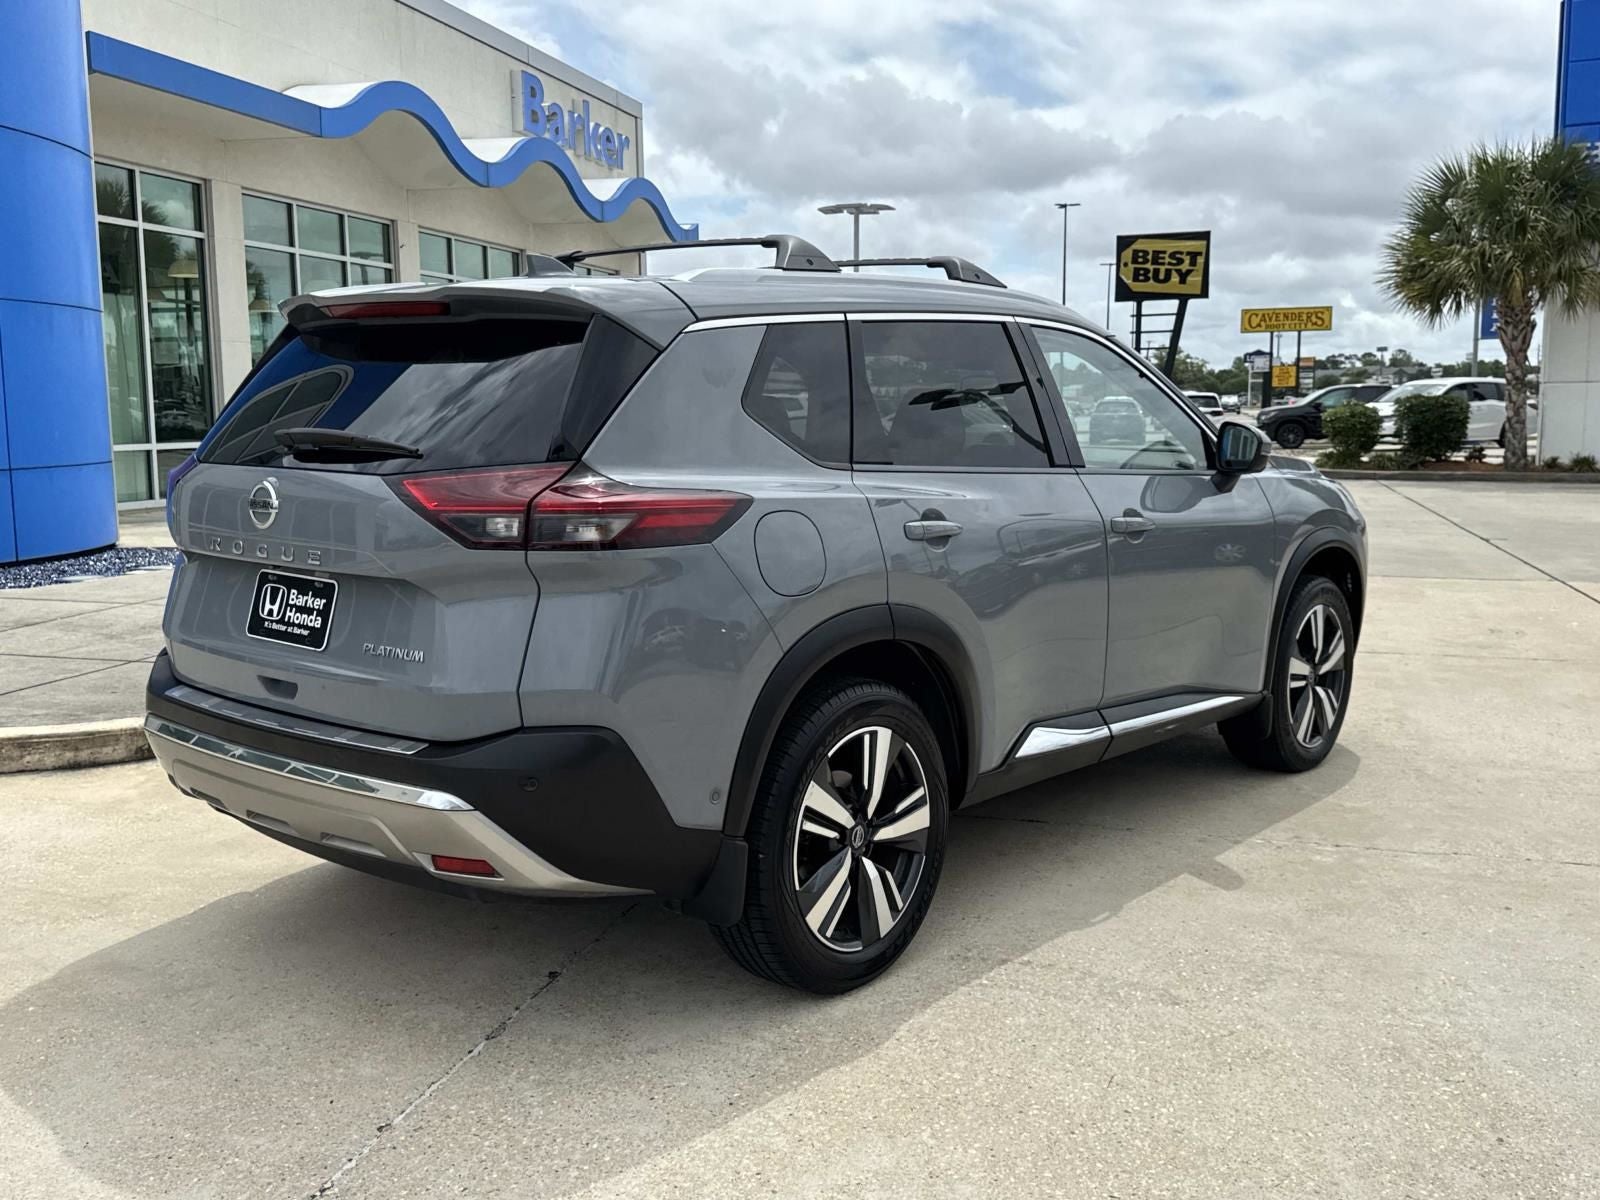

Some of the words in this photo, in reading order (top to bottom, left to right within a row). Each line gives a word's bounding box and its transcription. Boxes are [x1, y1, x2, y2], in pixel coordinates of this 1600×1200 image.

[520, 70, 630, 170] Barker
[1131, 249, 1203, 267] BEST
[1132, 267, 1195, 285] BUY
[1247, 311, 1325, 329] CAVENDER'S
[209, 537, 321, 565] ROGUE
[288, 589, 326, 610] Barker
[285, 606, 322, 628] Honda
[363, 642, 424, 662] PLATINUM
